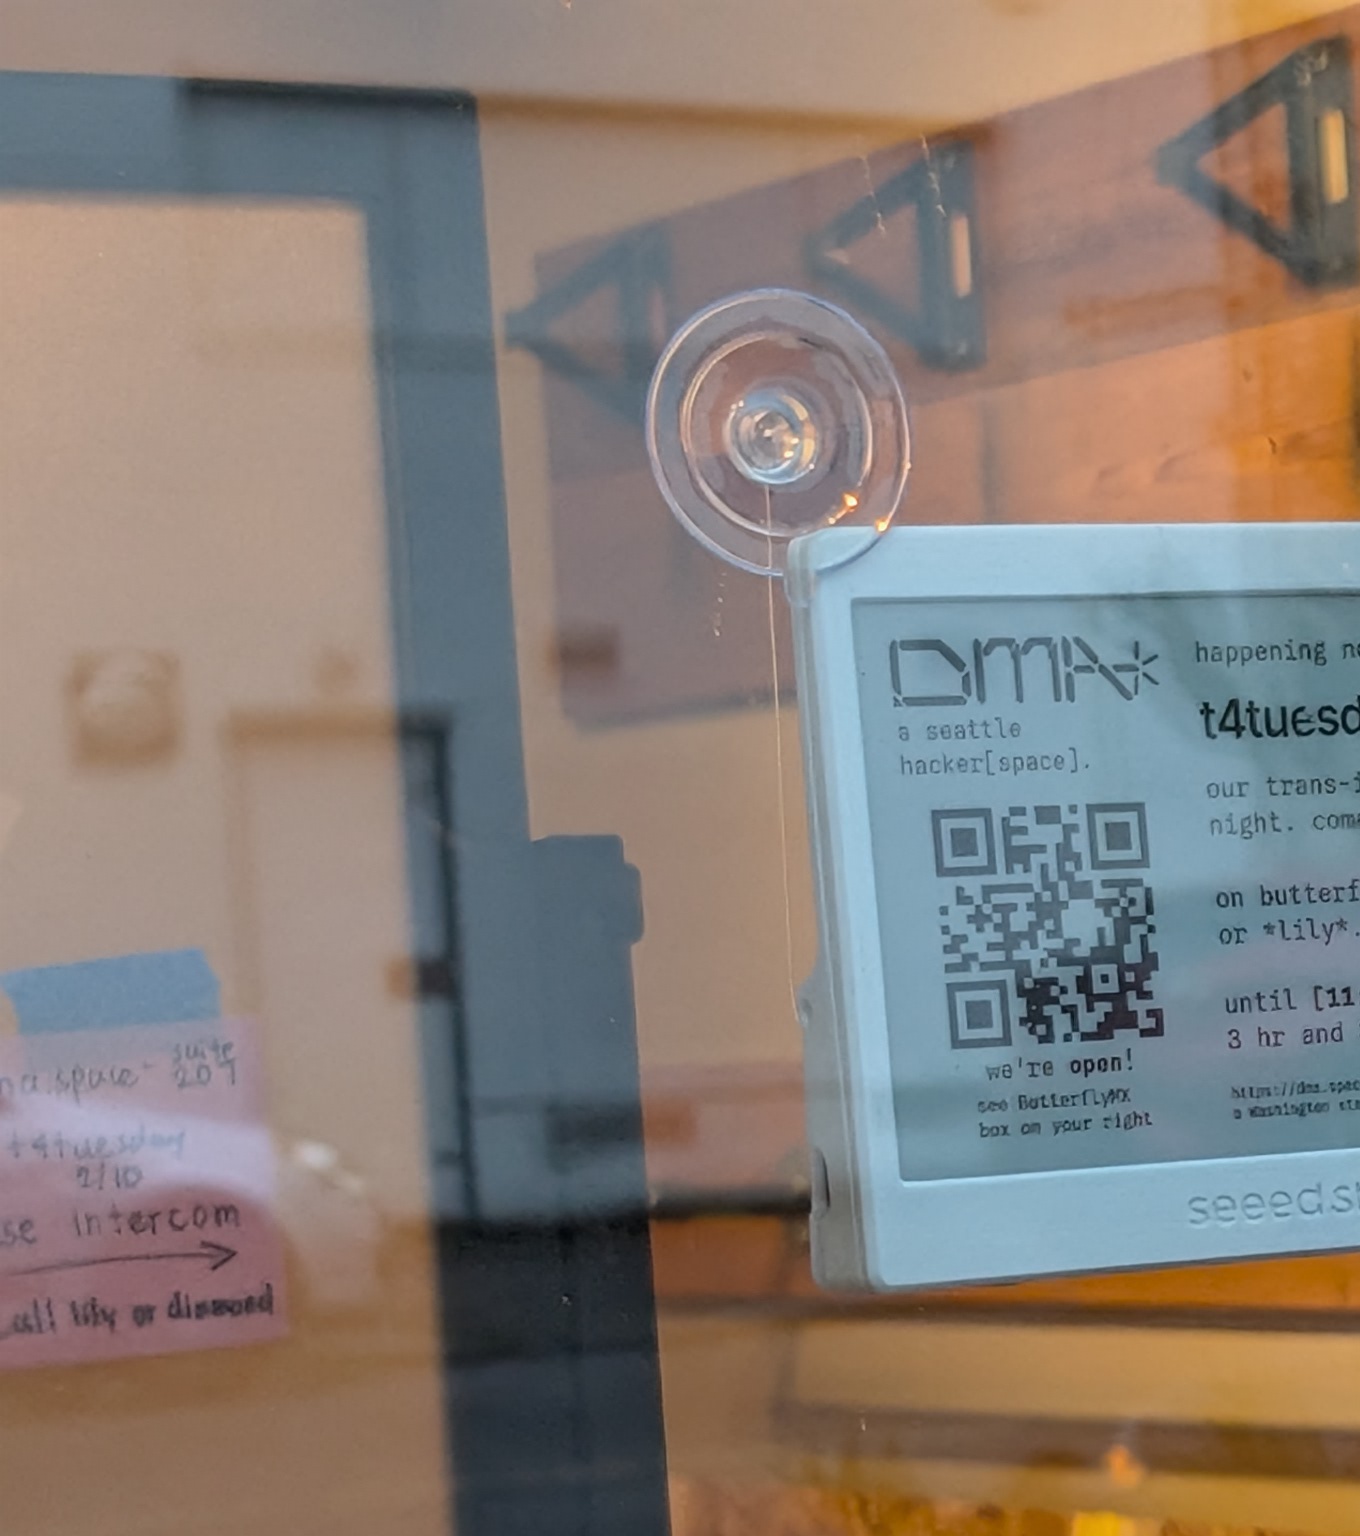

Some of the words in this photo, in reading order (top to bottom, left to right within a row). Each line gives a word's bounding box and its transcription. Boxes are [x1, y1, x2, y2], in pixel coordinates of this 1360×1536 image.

[1195, 639, 1327, 667] happening
[898, 725, 910, 741] a
[926, 717, 1022, 741] seattle
[900, 747, 1090, 776] hacker[space].
[1206, 779, 1250, 799] our
[1210, 810, 1293, 840] night.
[1216, 890, 1244, 908] on
[1219, 927, 1248, 946] or
[1225, 987, 1298, 1015] until
[1227, 1028, 1242, 1049] 3
[1258, 1023, 1285, 1047] hr
[1303, 1021, 1343, 1044] and
[985, 1057, 1054, 1081] we're
[1070, 1048, 1133, 1077] open!
[979, 1122, 1011, 1138] box
[1020, 1121, 1041, 1136] on
[1052, 1117, 1093, 1136] your
[1103, 1110, 1153, 1131] right
